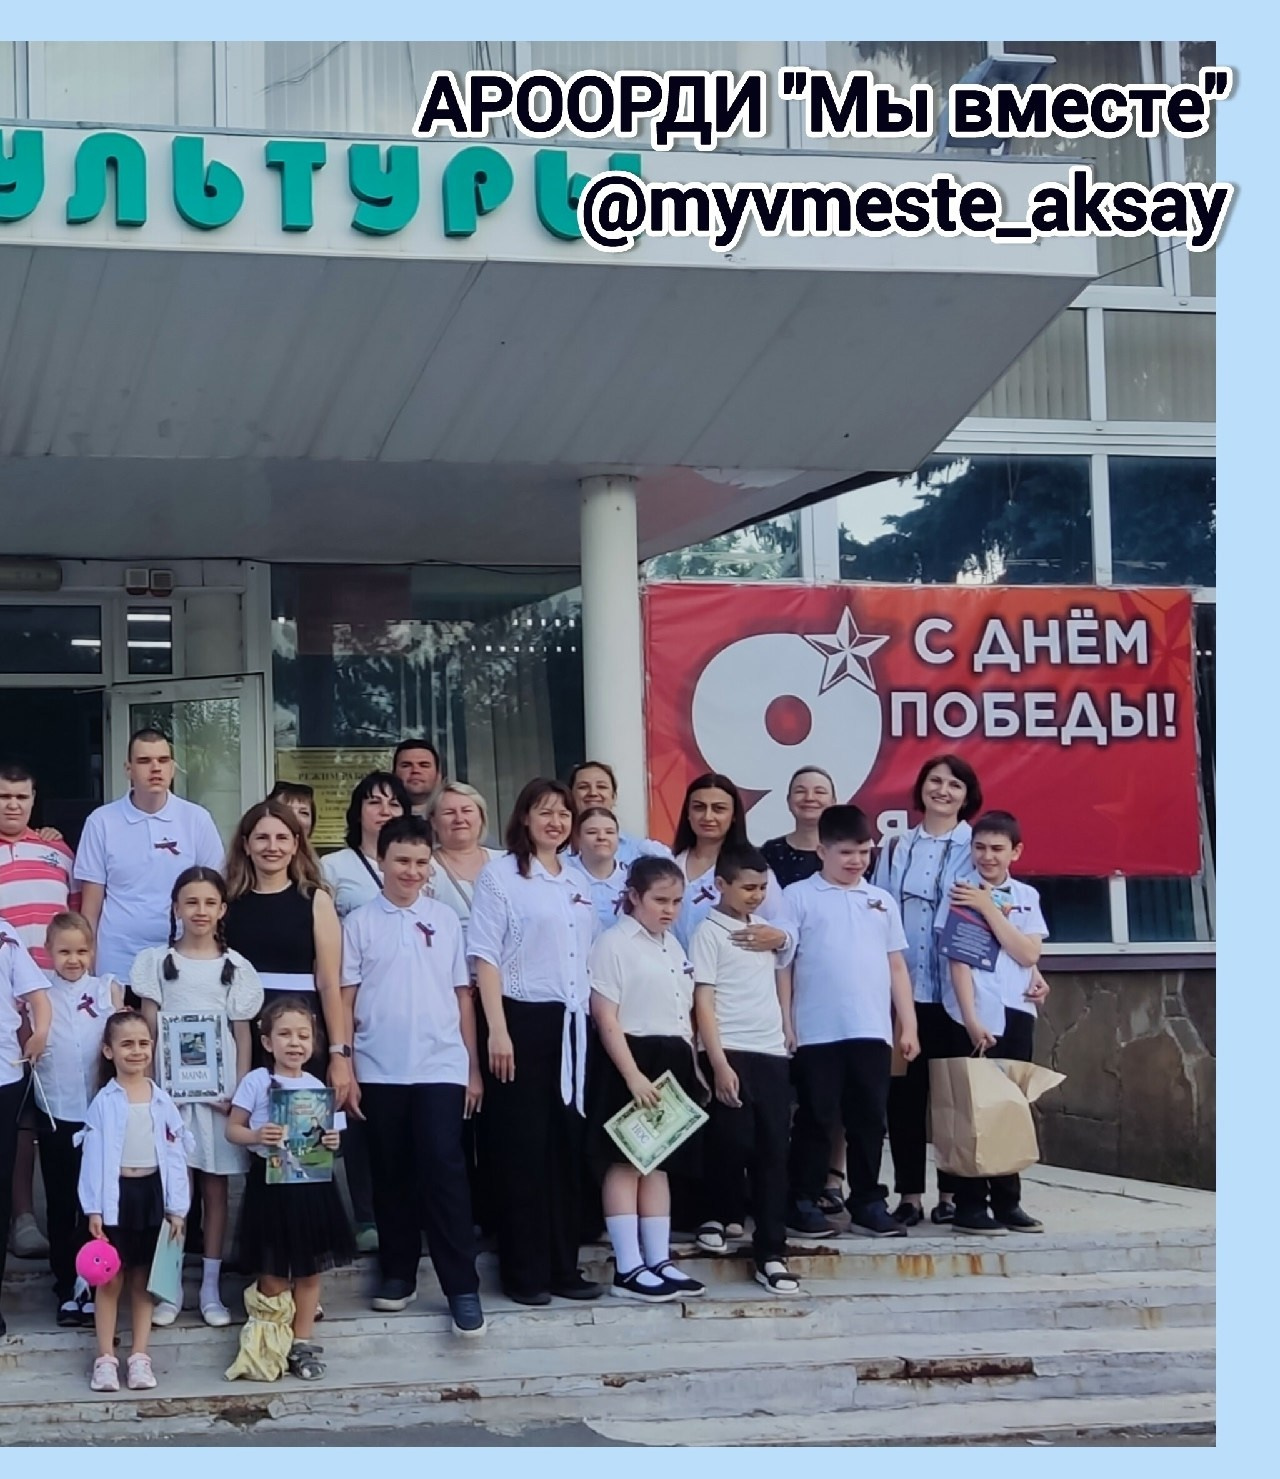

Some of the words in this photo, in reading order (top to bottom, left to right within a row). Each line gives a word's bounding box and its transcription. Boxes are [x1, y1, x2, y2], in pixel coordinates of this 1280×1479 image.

[915, 617, 955, 663] С
[972, 609, 1149, 672] ДНЁМ
[692, 633, 882, 847] 9
[890, 690, 1178, 747] ПОБЕДЫ!
